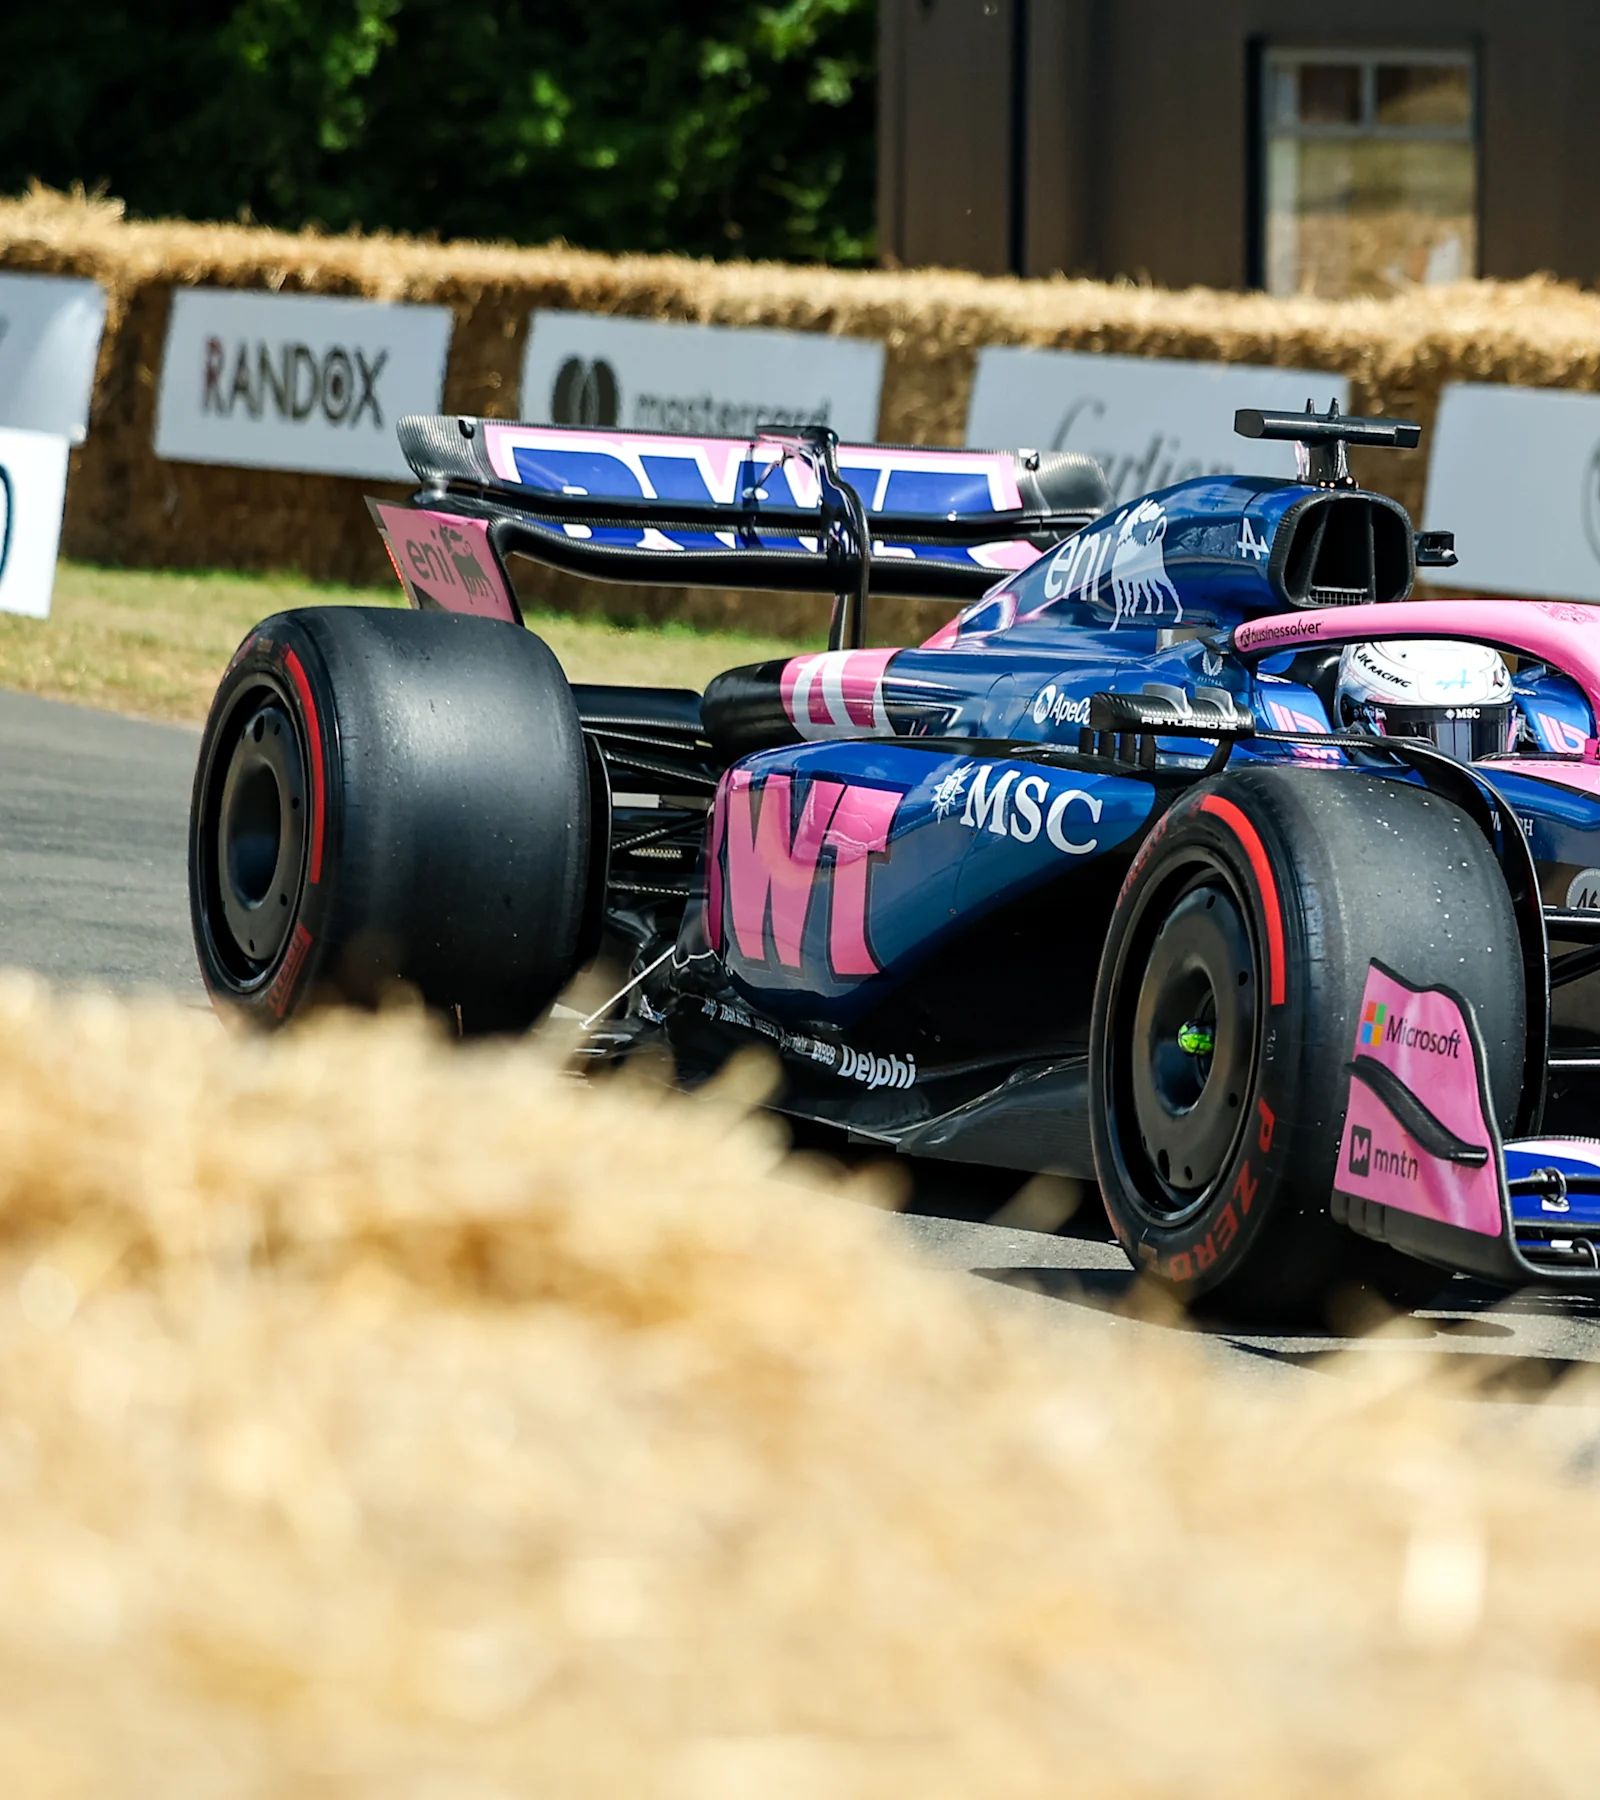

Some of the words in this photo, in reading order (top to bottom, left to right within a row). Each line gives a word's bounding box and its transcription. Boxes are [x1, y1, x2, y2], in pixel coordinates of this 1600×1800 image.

[204, 334, 389, 427] RANDOX
[405, 532, 452, 586] eni
[1044, 531, 1112, 602] eni
[1251, 619, 1322, 644] businessolver
[1368, 665, 1412, 688] RACING
[1455, 708, 1480, 719] MSC
[960, 765, 1103, 855] MSC
[1386, 1015, 1462, 1060] Microsoft
[837, 1043, 917, 1090] Delphi
[1374, 1146, 1419, 1180] mntn
